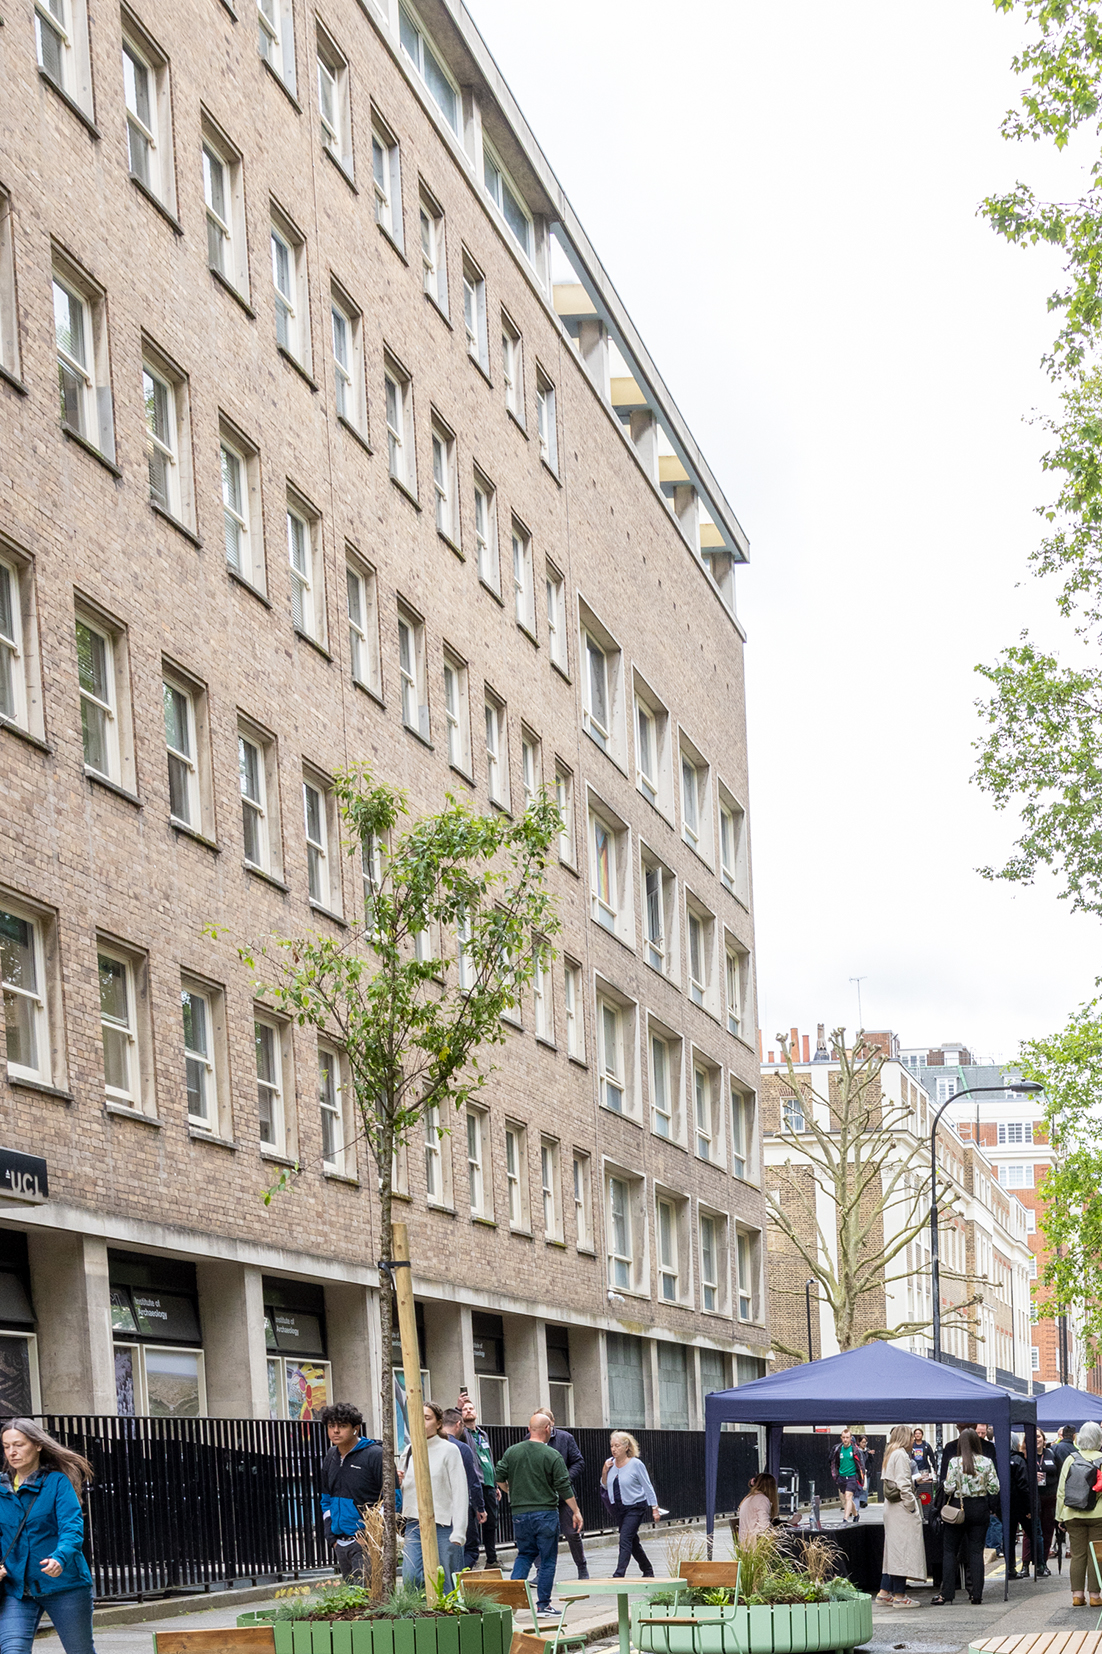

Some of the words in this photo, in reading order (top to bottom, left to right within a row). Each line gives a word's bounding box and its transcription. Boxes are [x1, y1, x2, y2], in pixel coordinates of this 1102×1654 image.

[11, 1170, 44, 1196] UCL
[137, 1307, 168, 1320] Archaeology
[275, 1316, 290, 1325] nstitute
[276, 1325, 299, 1337] Archaeology
